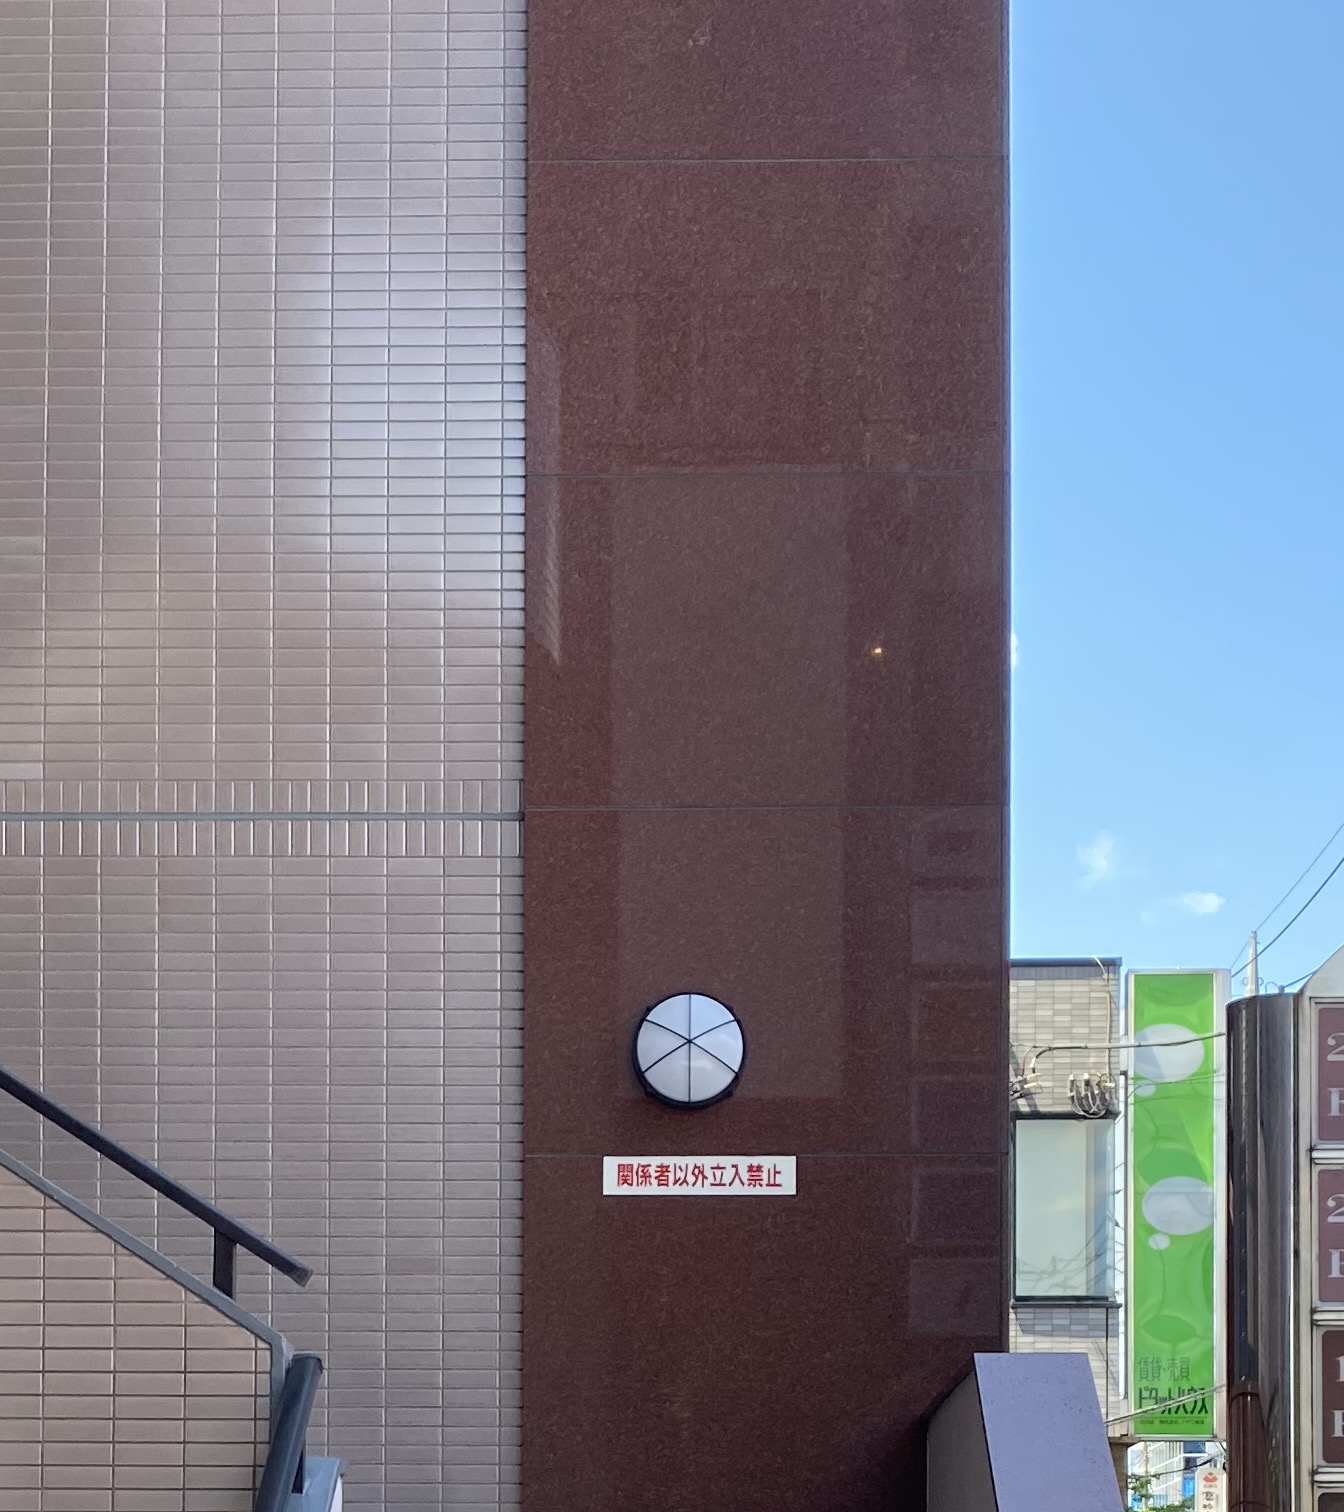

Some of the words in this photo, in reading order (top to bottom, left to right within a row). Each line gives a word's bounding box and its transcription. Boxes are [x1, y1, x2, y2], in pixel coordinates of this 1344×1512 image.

[616, 1162, 783, 1189] 関係者以外立入禁止
